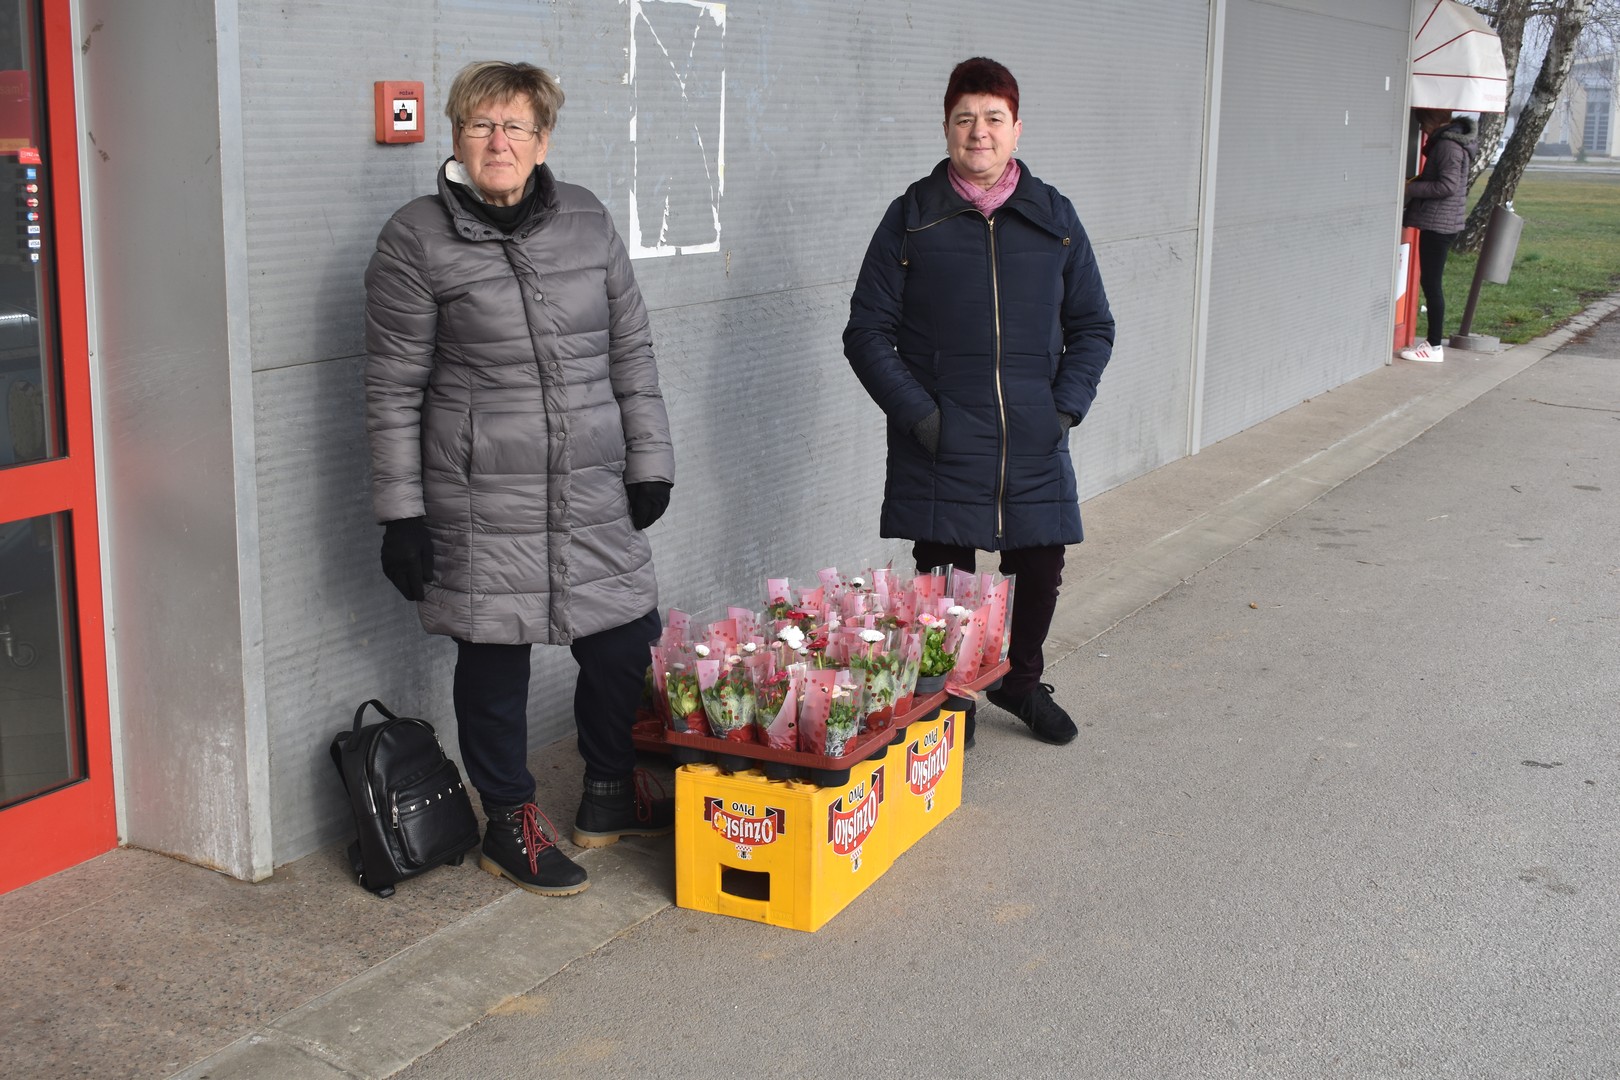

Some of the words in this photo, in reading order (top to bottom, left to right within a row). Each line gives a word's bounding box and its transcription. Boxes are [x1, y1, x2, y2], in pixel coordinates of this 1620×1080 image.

[924, 727, 938, 747] Pivo
[912, 736, 948, 792] Ožujsko
[848, 782, 864, 804] Pivo
[732, 802, 755, 816] Pivo
[835, 790, 876, 851] Ožujsko
[714, 812, 773, 844] Ožujsko
